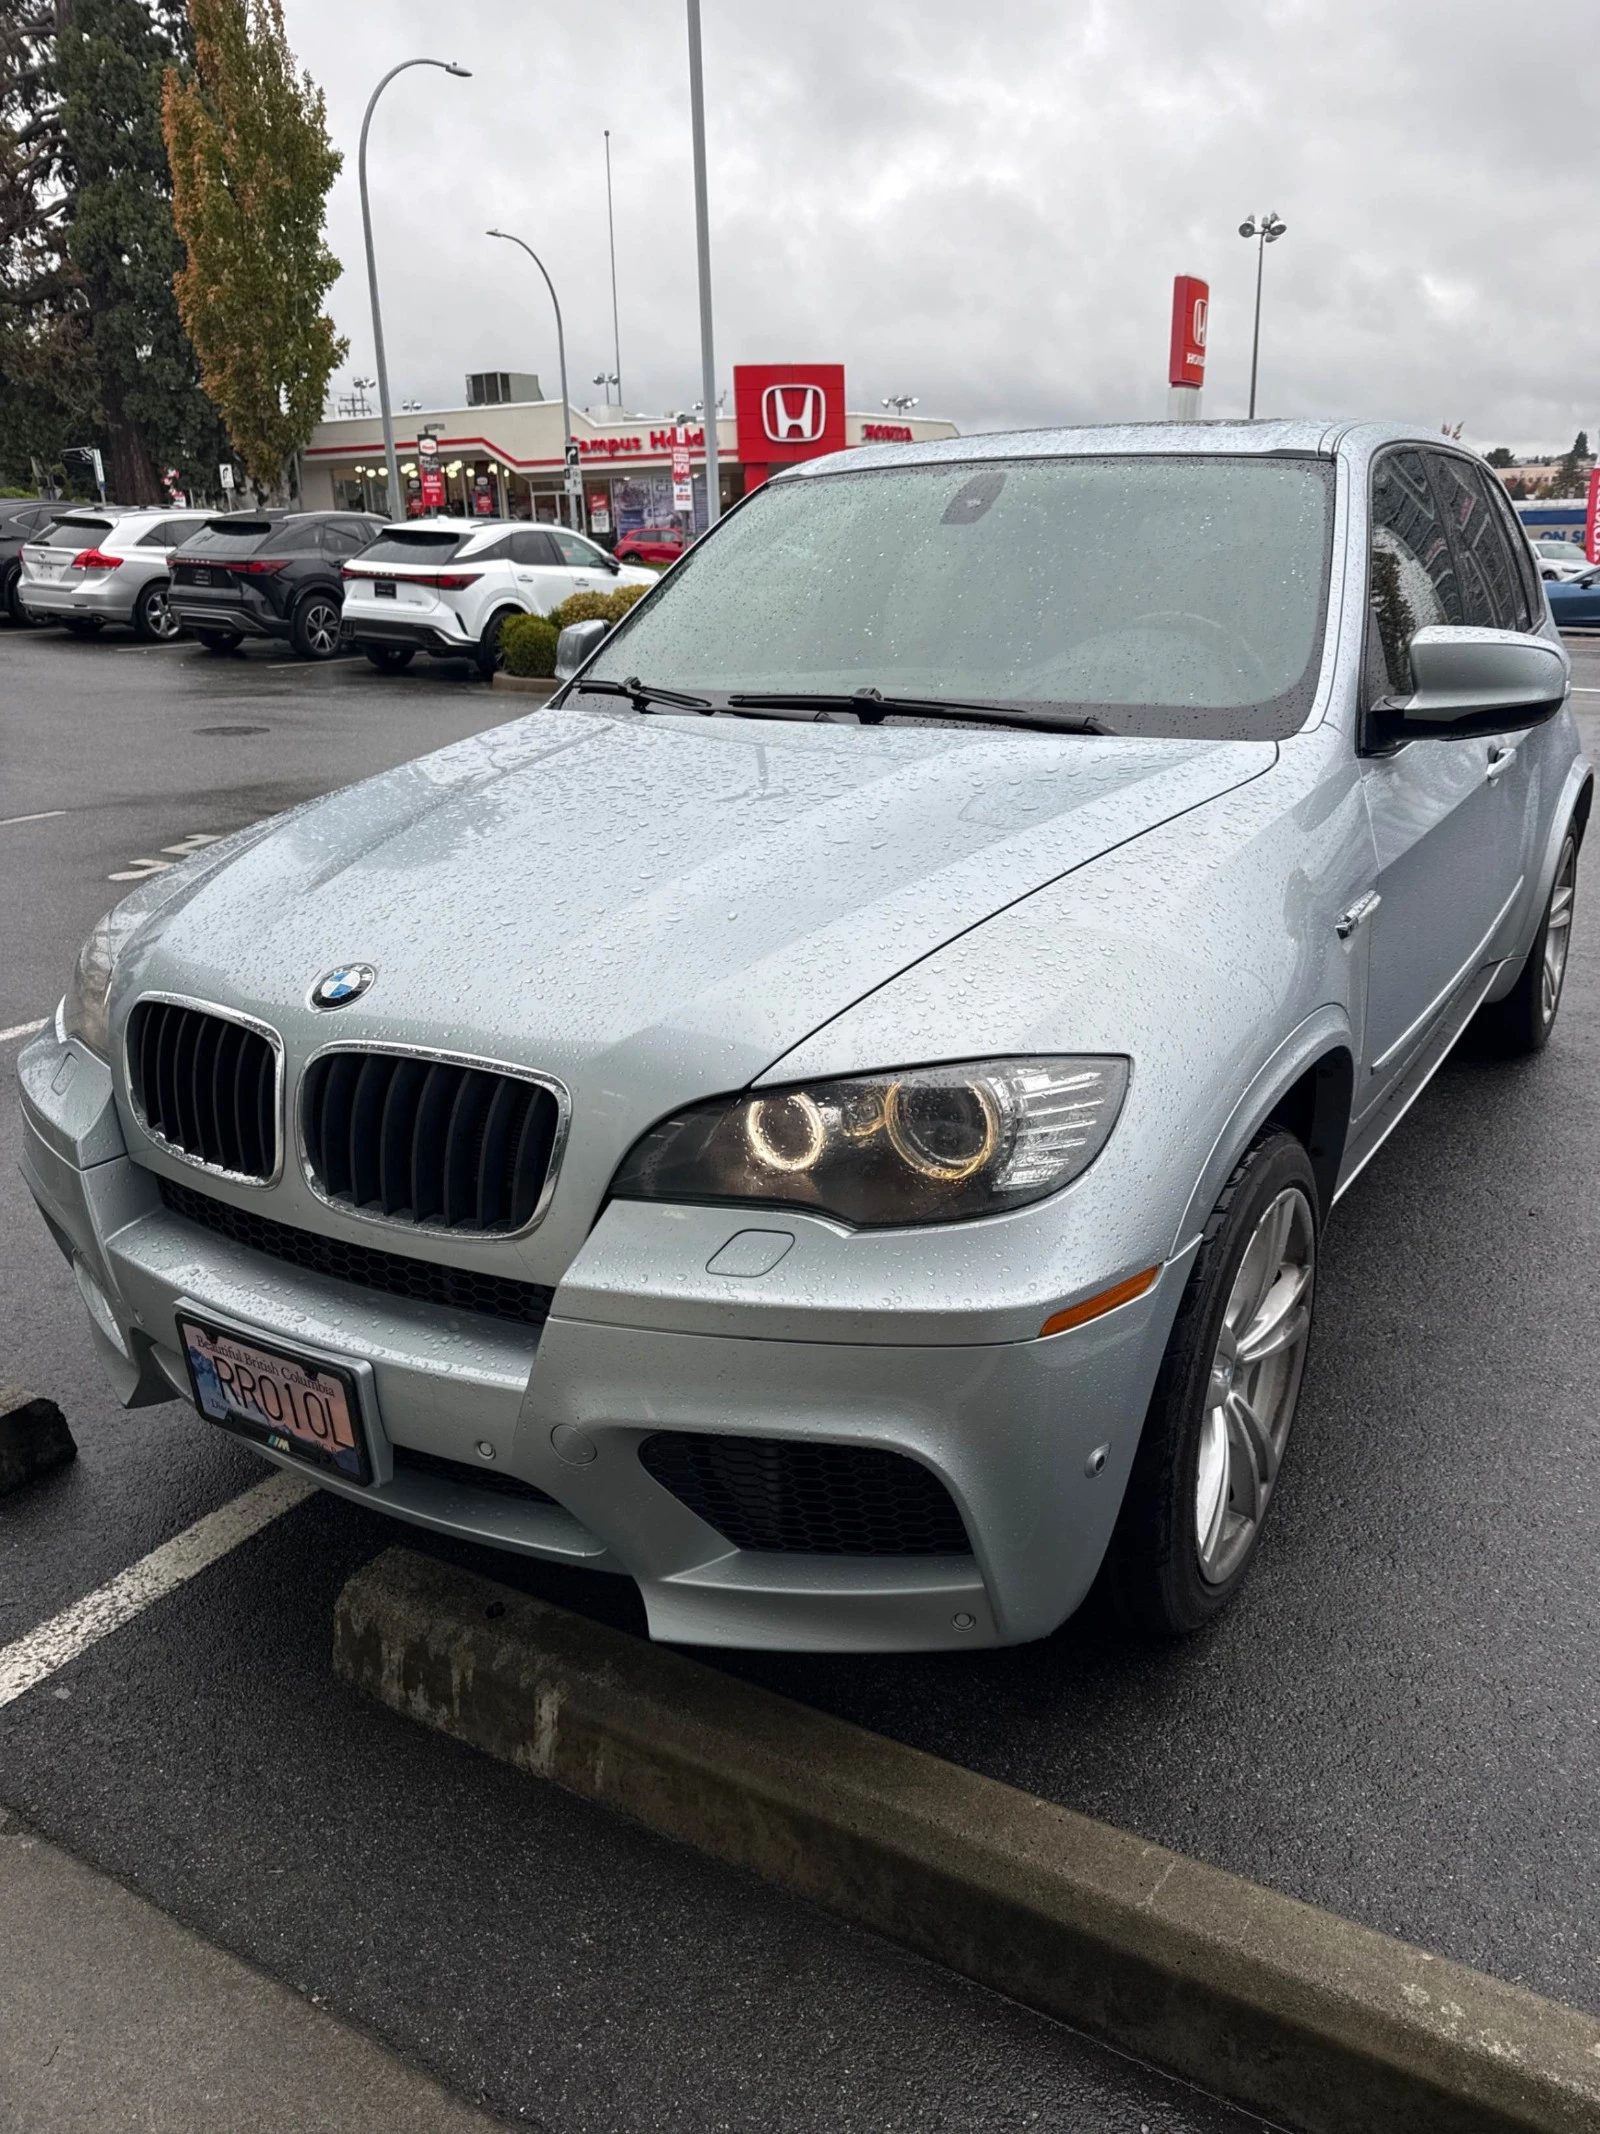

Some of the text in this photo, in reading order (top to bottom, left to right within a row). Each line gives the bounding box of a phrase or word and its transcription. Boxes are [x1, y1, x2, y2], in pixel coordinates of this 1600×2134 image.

[196, 1334, 334, 1398] Beautiful British Columbia
